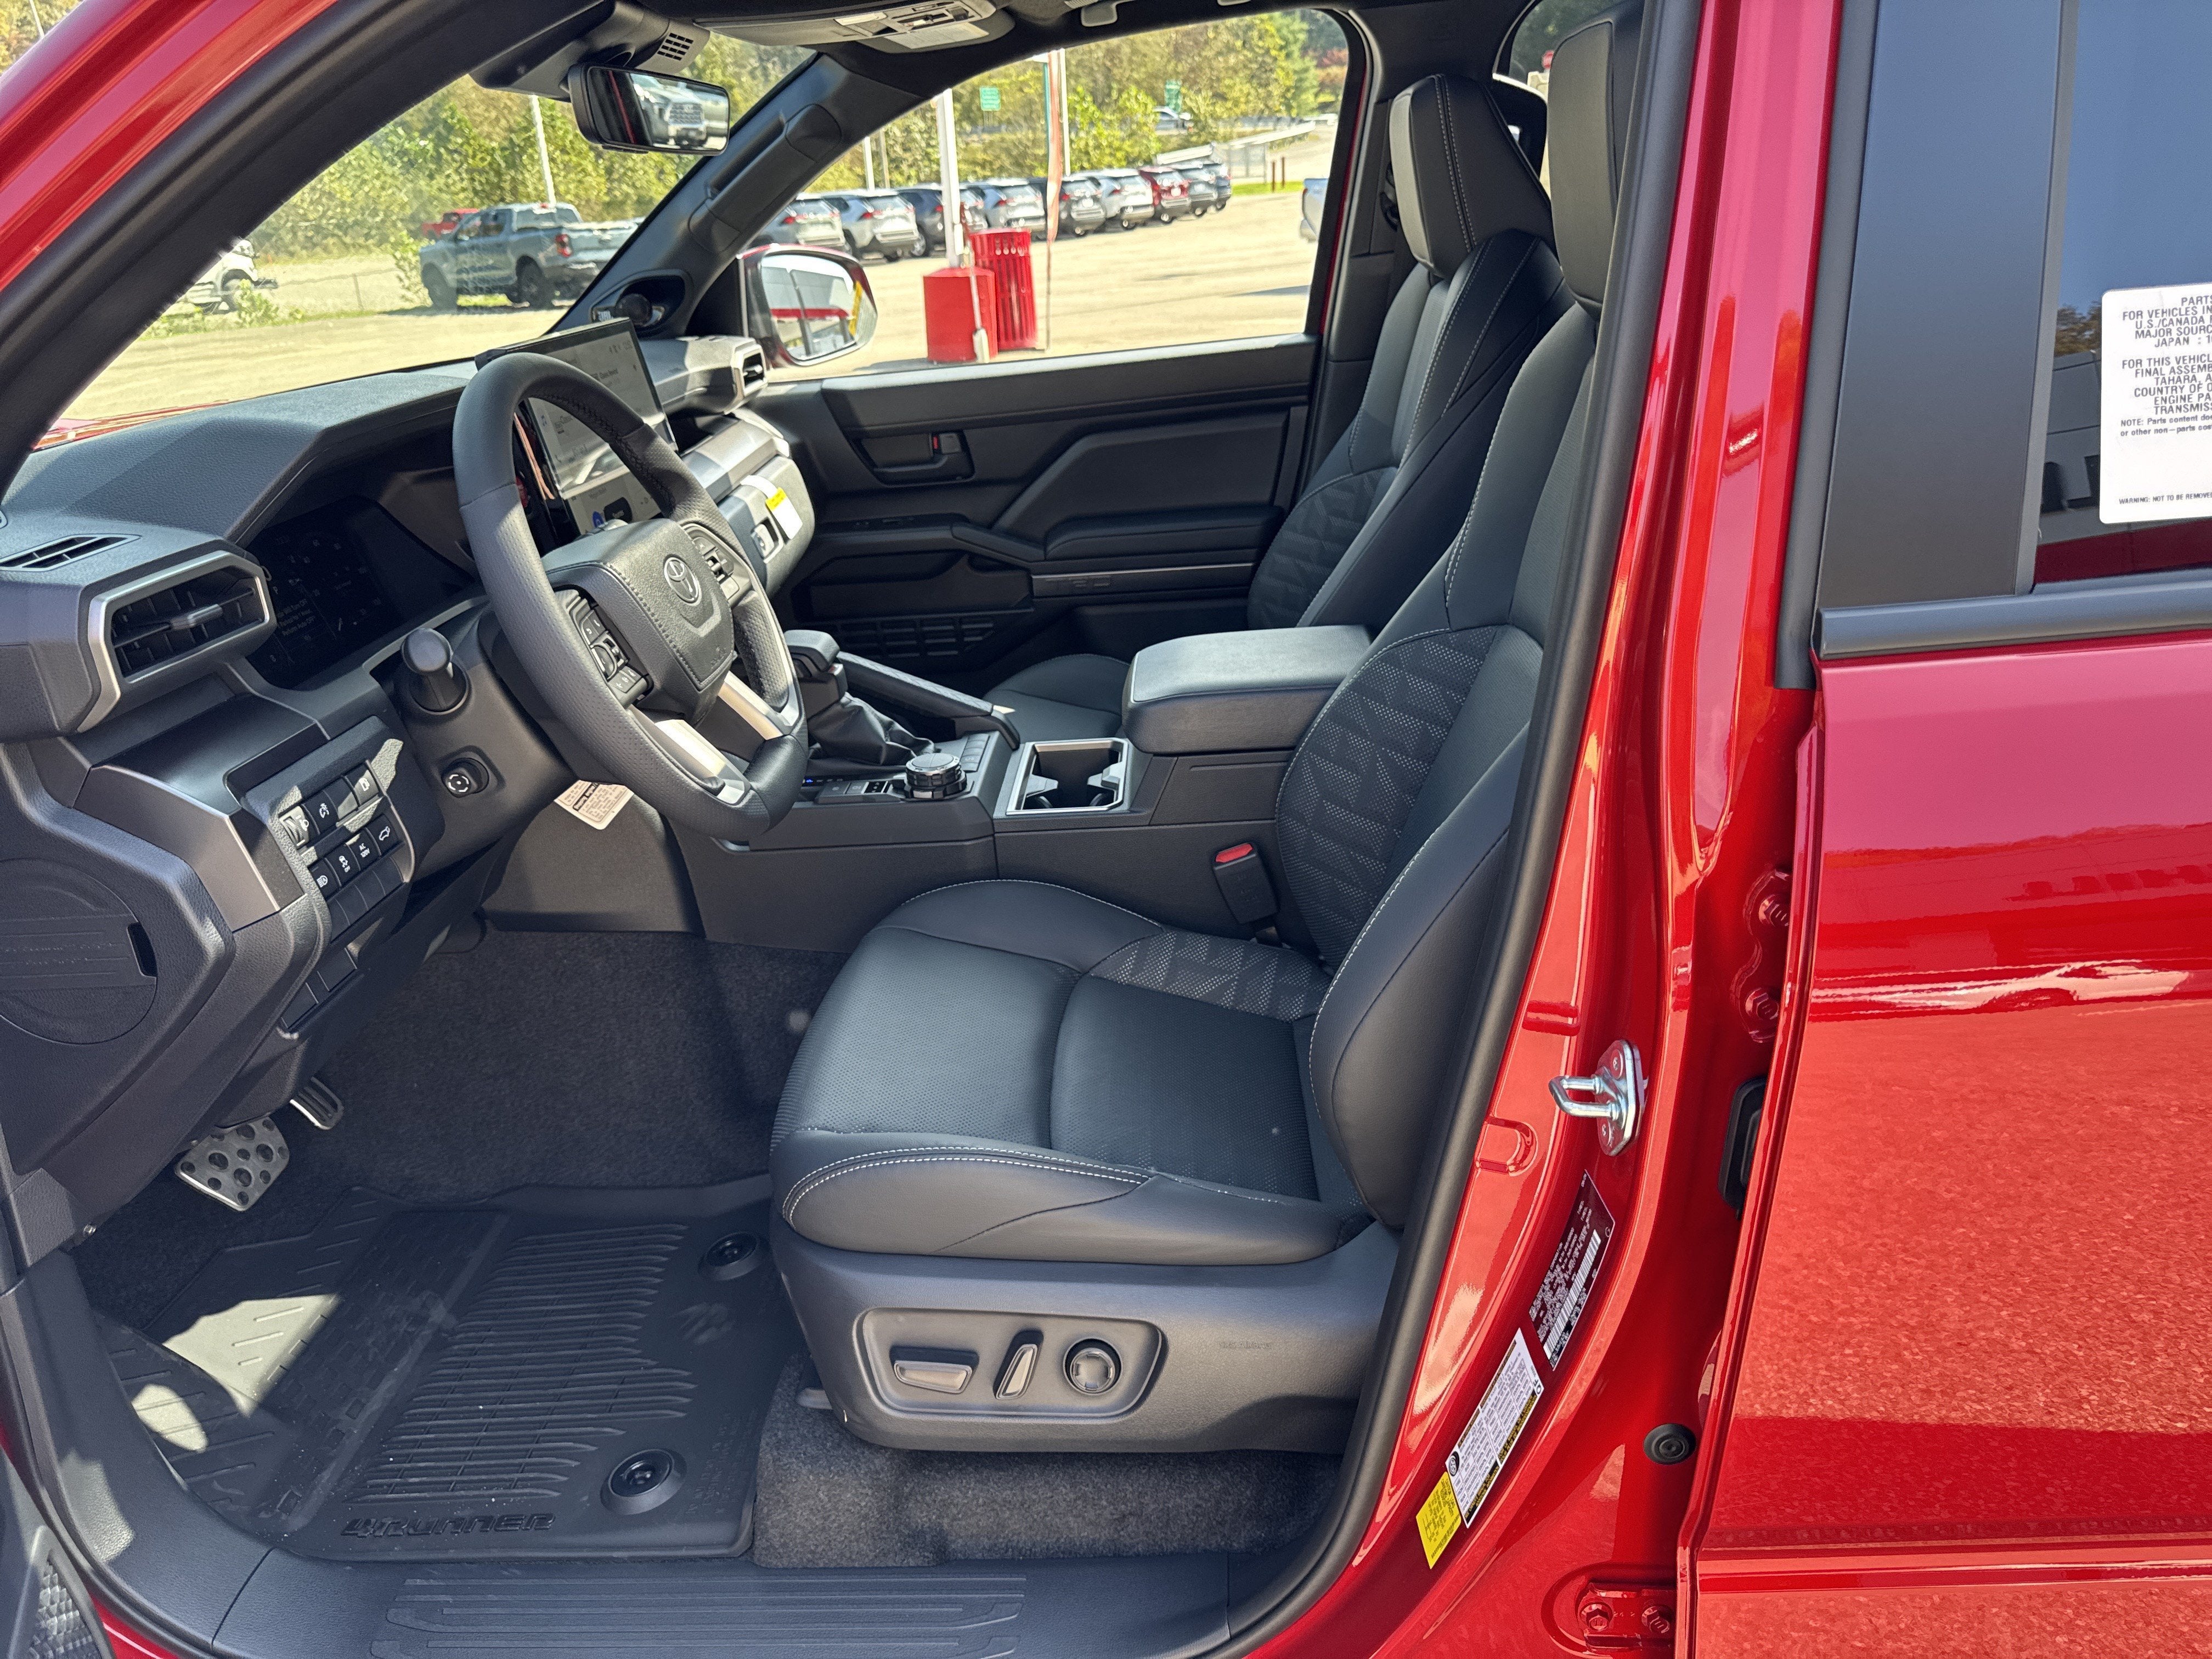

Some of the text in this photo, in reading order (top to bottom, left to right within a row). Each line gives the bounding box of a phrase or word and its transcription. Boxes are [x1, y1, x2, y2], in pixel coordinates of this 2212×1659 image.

[2122, 310, 2143, 321] FOR
[2147, 306, 2198, 319] VEHICLES
[2135, 315, 2205, 330] U.S./CANADA
[2135, 324, 2212, 340] MAJOR SOURC
[2154, 336, 2190, 348] JAPAN
[2121, 353, 2212, 369] FOR THIS VEHICL
[2135, 366, 2166, 378] FINAL
[2154, 374, 2202, 386] TAHARA,
[2134, 385, 2185, 398] COUNTRY
[2189, 383, 2203, 393] OF
[2154, 393, 2193, 405] ENGINE
[2120, 418, 2144, 427] NOTE:
[2147, 417, 2166, 425] Parts
[2169, 414, 2198, 424] content
[2131, 428, 2151, 436] other
[2119, 496, 2151, 505] WARNING:
